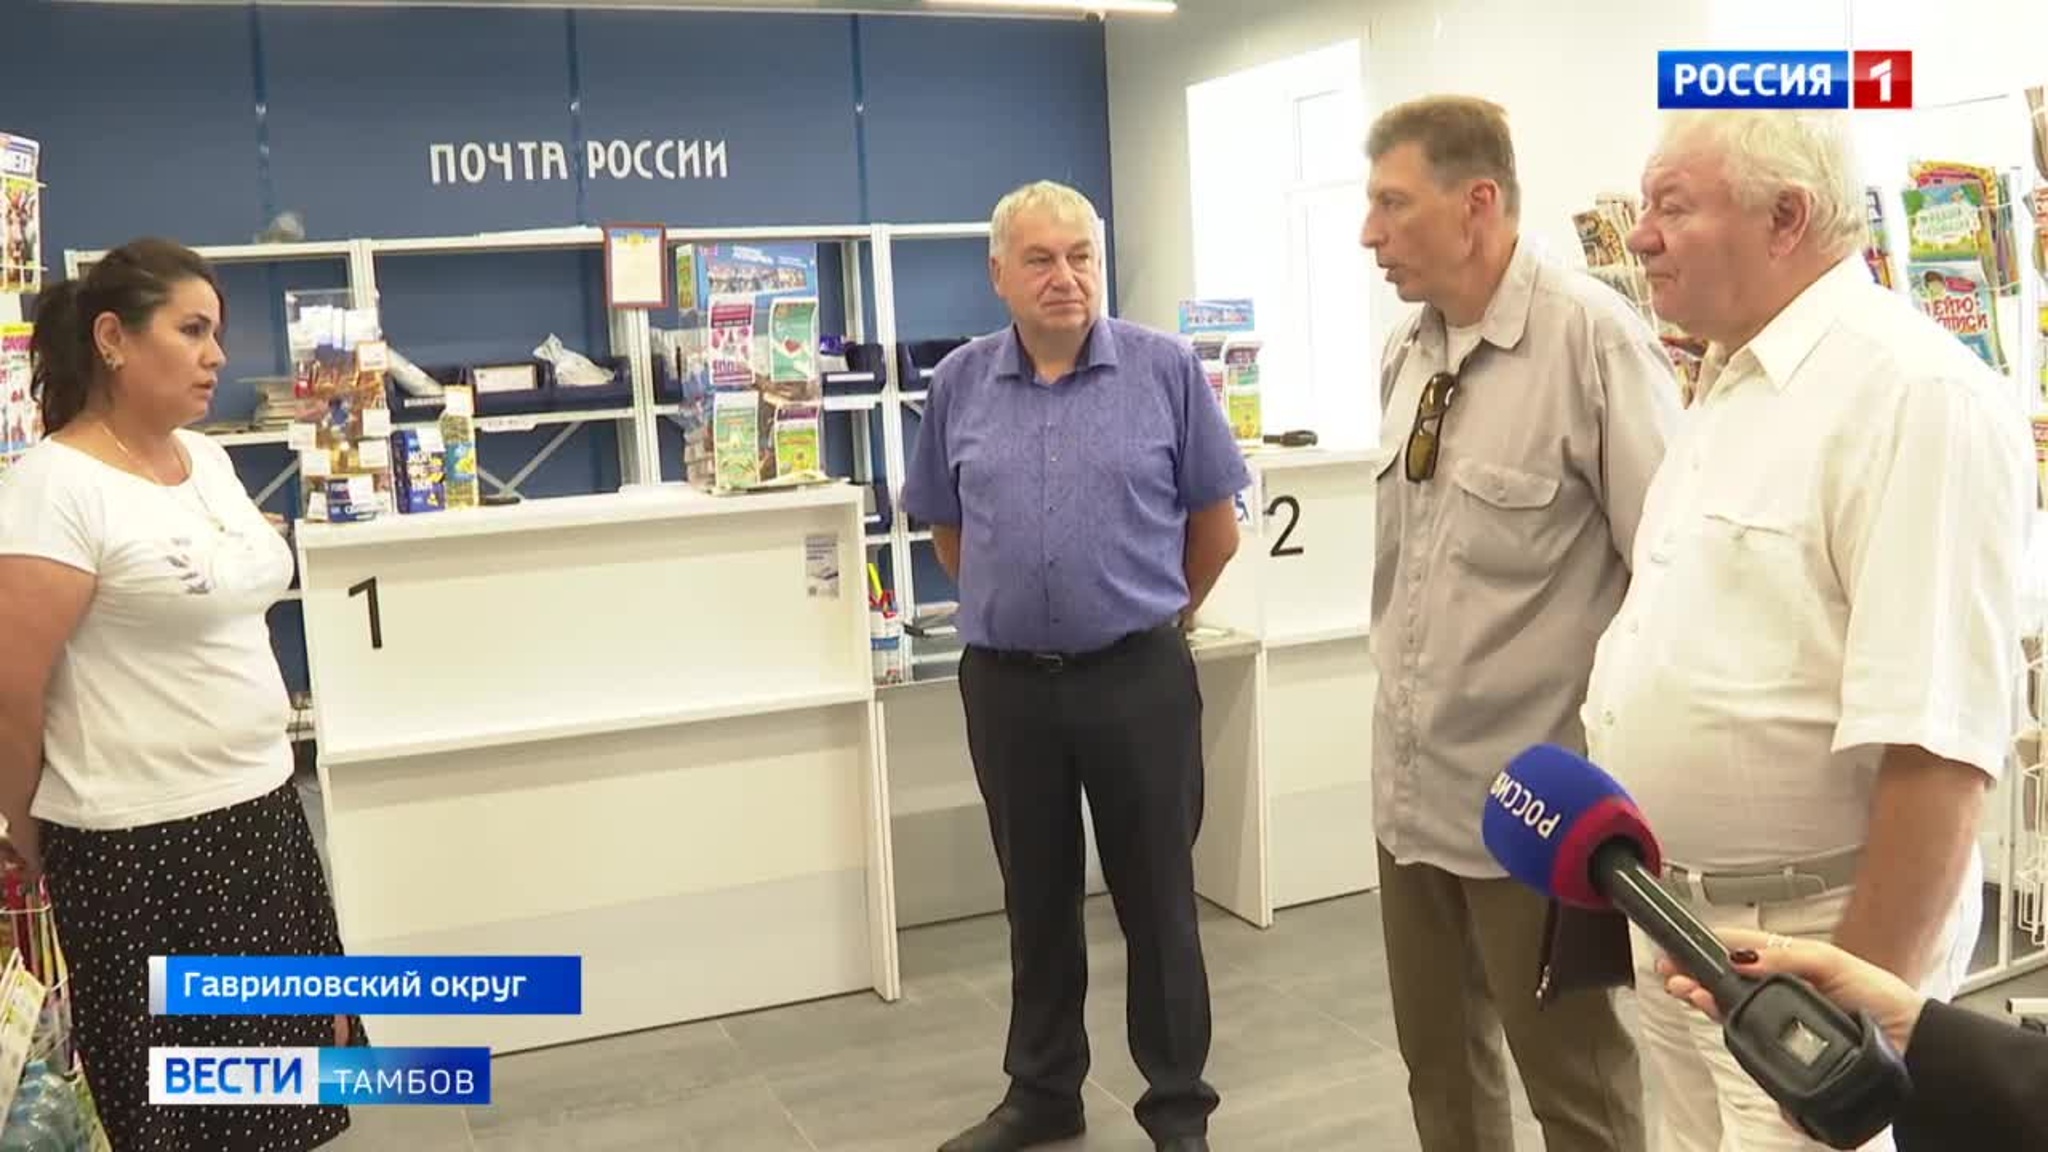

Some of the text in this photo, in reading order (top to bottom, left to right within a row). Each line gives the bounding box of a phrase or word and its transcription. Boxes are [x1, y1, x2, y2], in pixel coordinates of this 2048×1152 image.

[429, 139, 729, 184] ПОЧТА РОССИИ
[1266, 494, 1304, 557] 2
[348, 575, 382, 649] 1
